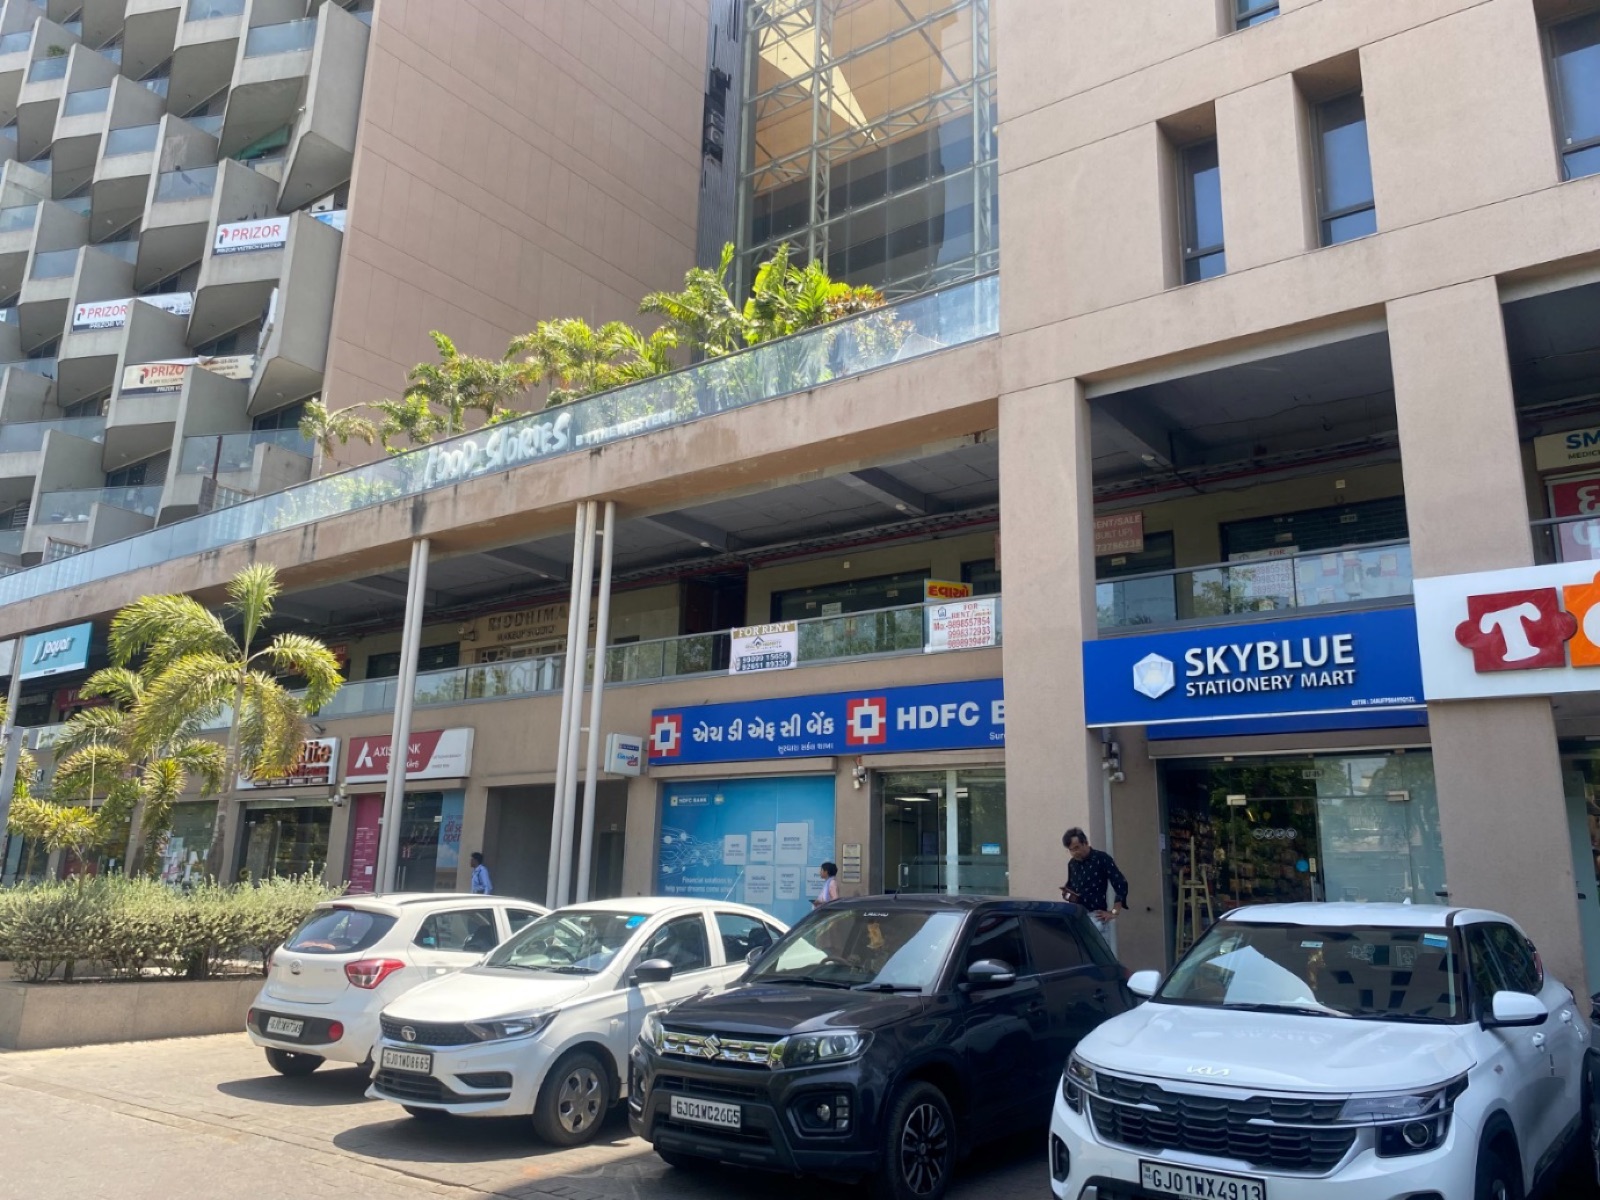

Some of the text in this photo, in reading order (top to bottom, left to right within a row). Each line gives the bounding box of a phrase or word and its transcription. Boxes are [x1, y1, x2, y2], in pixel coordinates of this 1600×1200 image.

[231, 224, 280, 240] PRIZOR
[87, 305, 128, 319] PRIZOR
[739, 622, 790, 637] FOR RENT
[1184, 633, 1355, 678] SKYBLUE
[1186, 669, 1356, 697] STATIONERY MART
[692, 710, 835, 743] એચ ડી એફ સી બેંક
[897, 701, 980, 731] HDFC
[1153, 1169, 1261, 1200] GJ01WX4913
